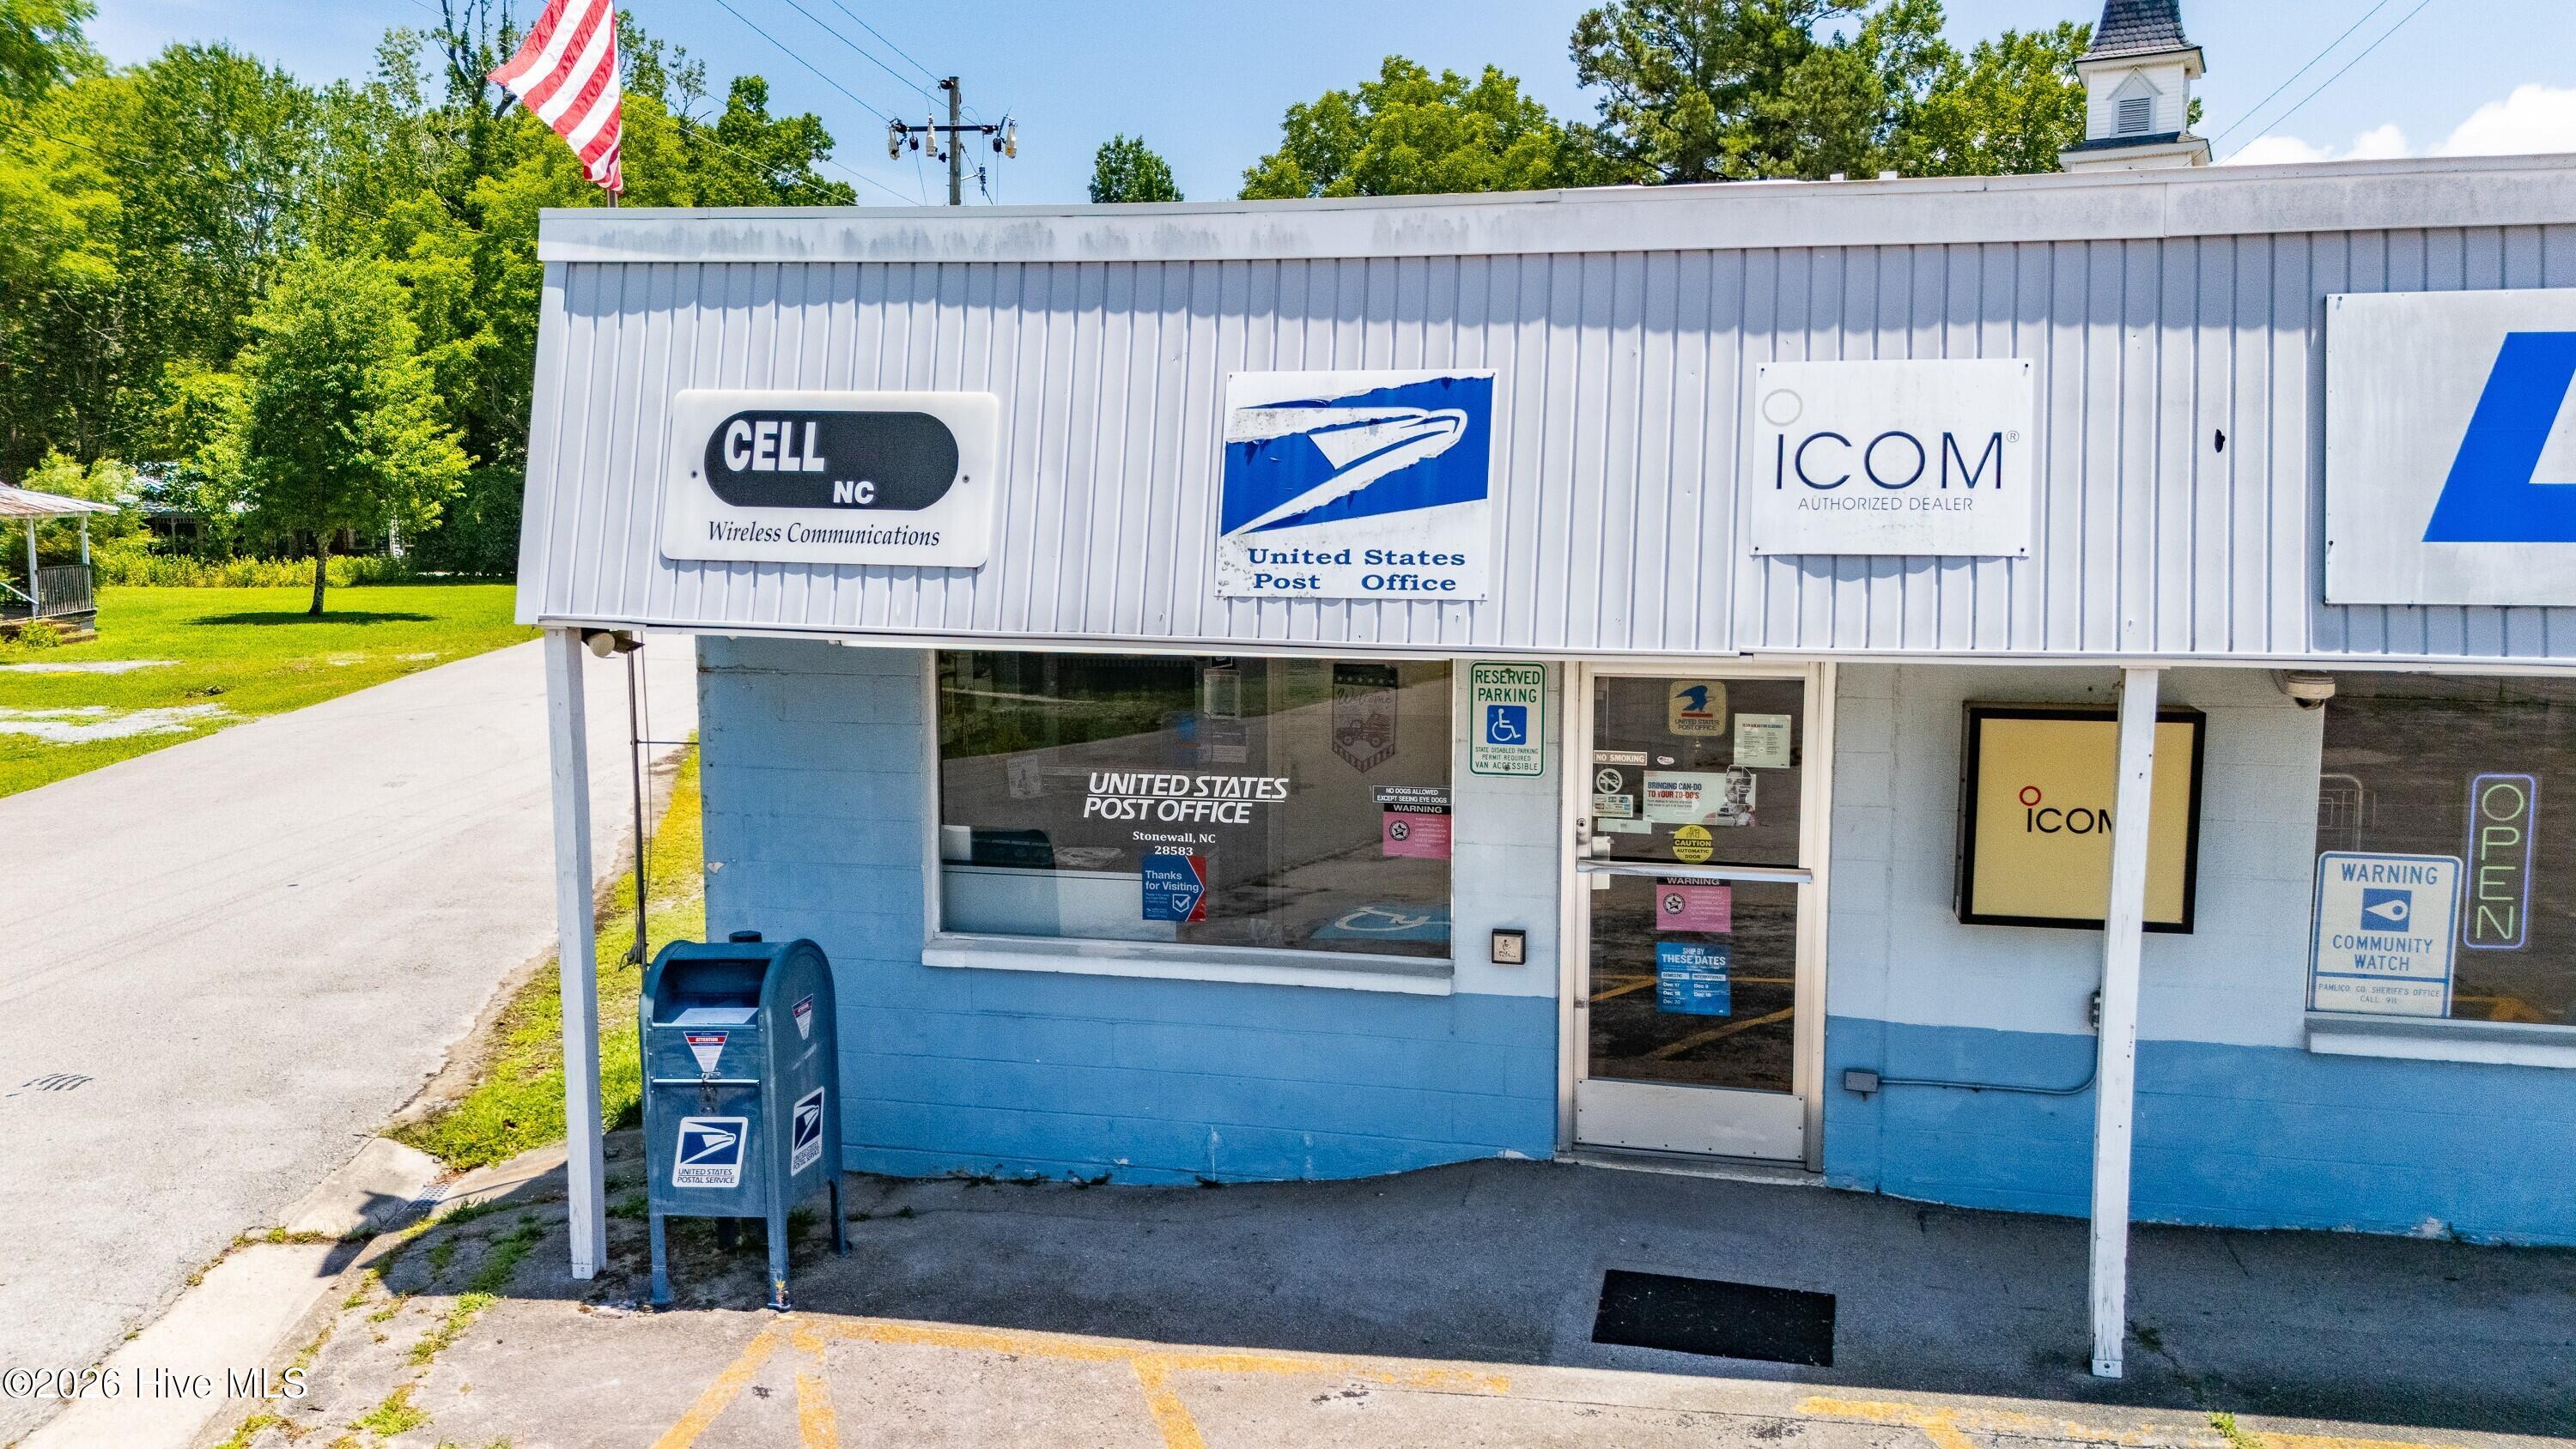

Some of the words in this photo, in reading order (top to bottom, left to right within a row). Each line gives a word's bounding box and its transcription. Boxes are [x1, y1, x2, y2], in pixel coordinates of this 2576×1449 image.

[724, 419, 825, 472] CELL
[833, 481, 874, 504] NC
[1798, 497, 1902, 511] AUTHORIZED
[1909, 497, 1973, 511] DEALER
[708, 520, 781, 543] Wireless
[787, 522, 940, 546] Communications
[1248, 549, 1352, 566] United
[1364, 549, 1466, 567] States
[1254, 573, 1321, 590] Post
[1361, 574, 1456, 591] Office
[1475, 670, 1540, 685] RESERVED
[1478, 688, 1537, 703] PARKING
[1089, 772, 1190, 796] UNITED
[1194, 775, 1289, 799] STATES
[1084, 797, 1154, 820] POST
[1157, 800, 1253, 823] OFFICE
[1393, 804, 1443, 813] WARNING
[1133, 831, 1196, 844] Stonewall,
[1199, 834, 1216, 844] NC
[1154, 846, 1194, 856] 28583
[2477, 784, 2524, 939] OPEN
[1145, 870, 1182, 880] Thanks
[2341, 863, 2438, 885] WARNING
[1145, 881, 1159, 890] for
[1163, 882, 1199, 893] Visiting
[2332, 934, 2433, 954] COMMUNITY
[1662, 954, 1692, 964] THESE
[1695, 955, 1726, 966] DATES
[2354, 954, 2410, 972] WATCH
[2318, 983, 2350, 991] PAMLICO
[2413, 989, 2439, 997] OFFICE
